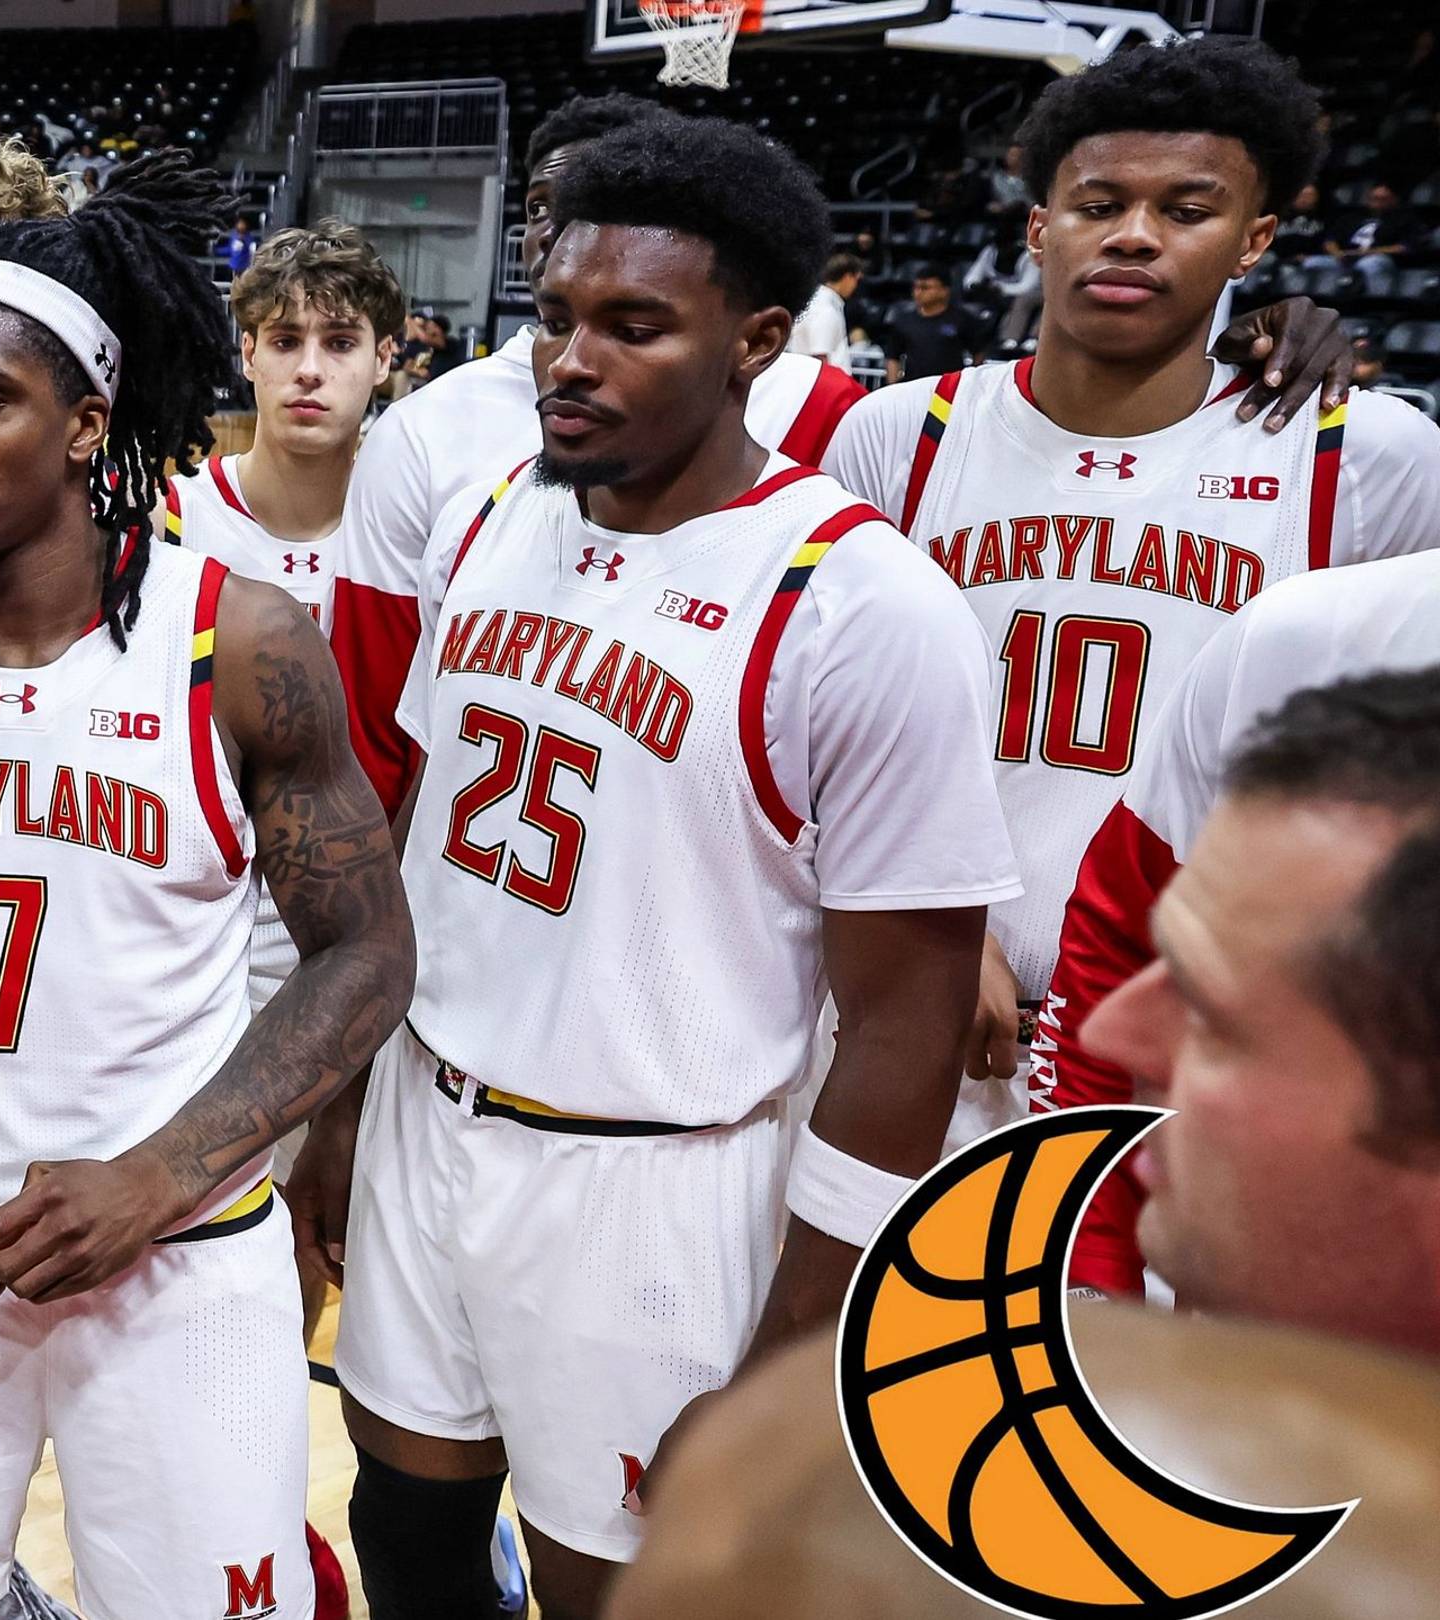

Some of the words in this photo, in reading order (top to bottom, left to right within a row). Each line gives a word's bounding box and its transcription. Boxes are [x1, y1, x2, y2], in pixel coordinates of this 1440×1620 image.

[928, 515, 1265, 615] MARYLAND
[435, 609, 693, 763] MARYLAND
[994, 609, 1151, 776] 10
[442, 702, 601, 916] 25
